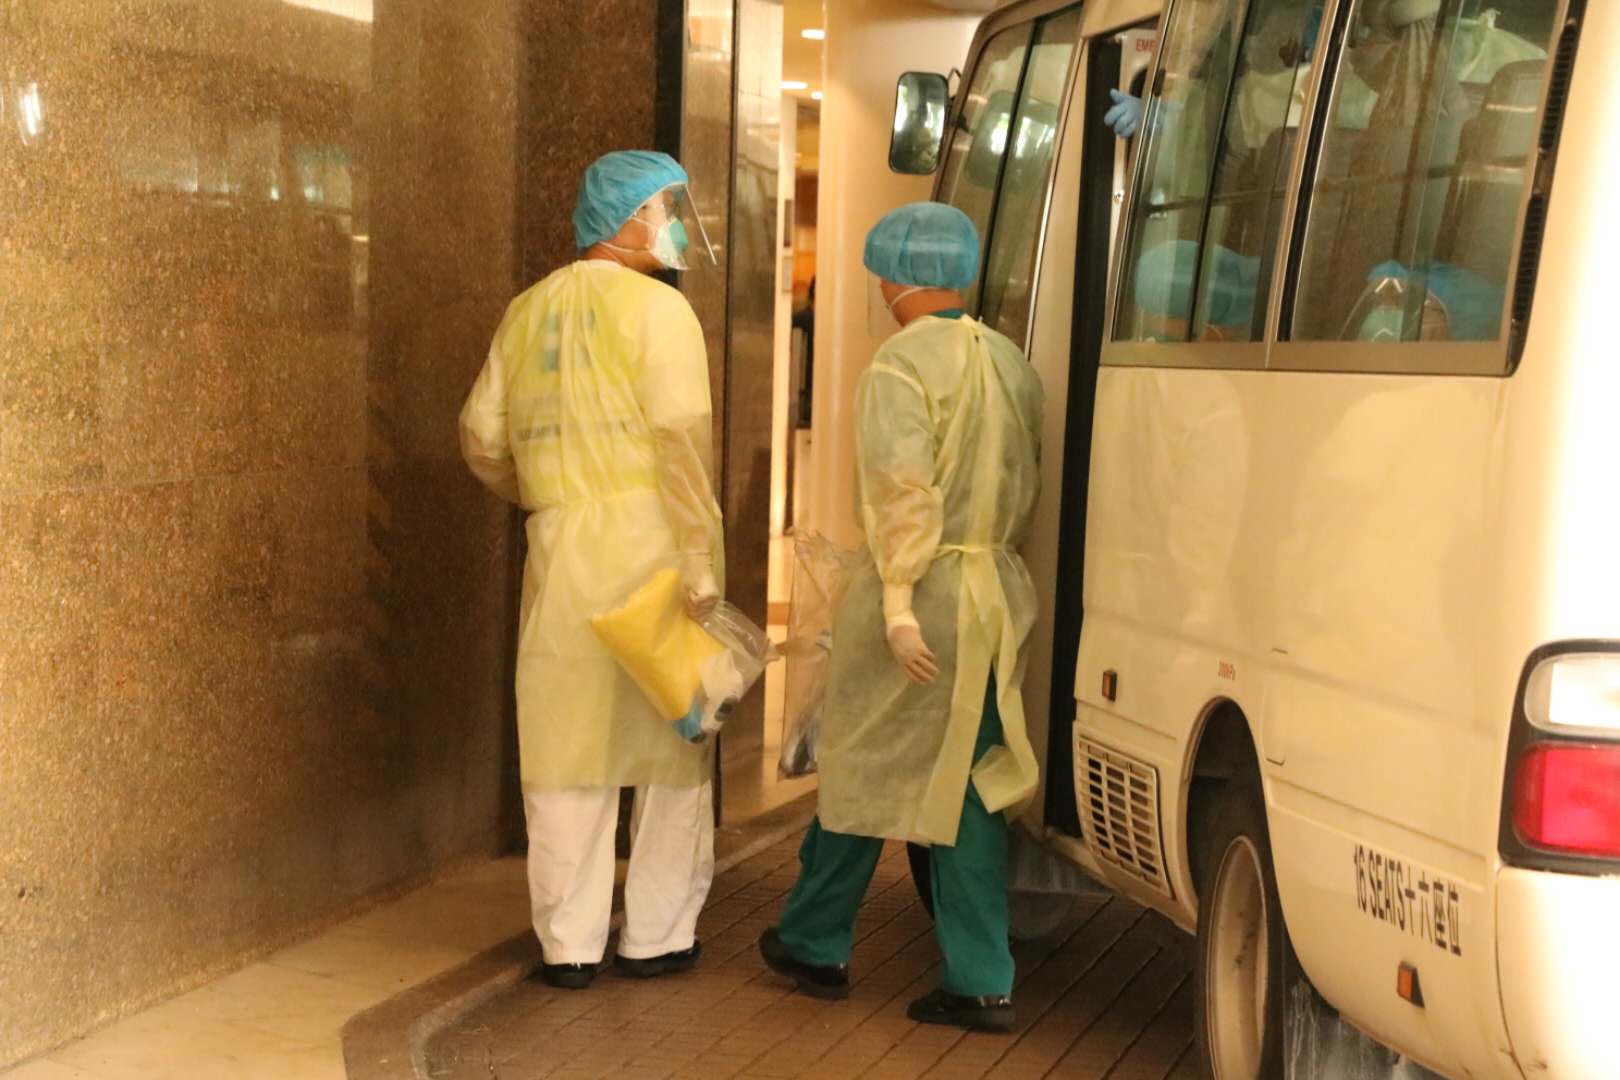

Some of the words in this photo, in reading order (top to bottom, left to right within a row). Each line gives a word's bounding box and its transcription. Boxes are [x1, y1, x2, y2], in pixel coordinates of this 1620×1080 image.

[1354, 844, 1367, 913] 16
[1368, 850, 1405, 931] SEATS
[1405, 864, 1462, 957] 十六座位
